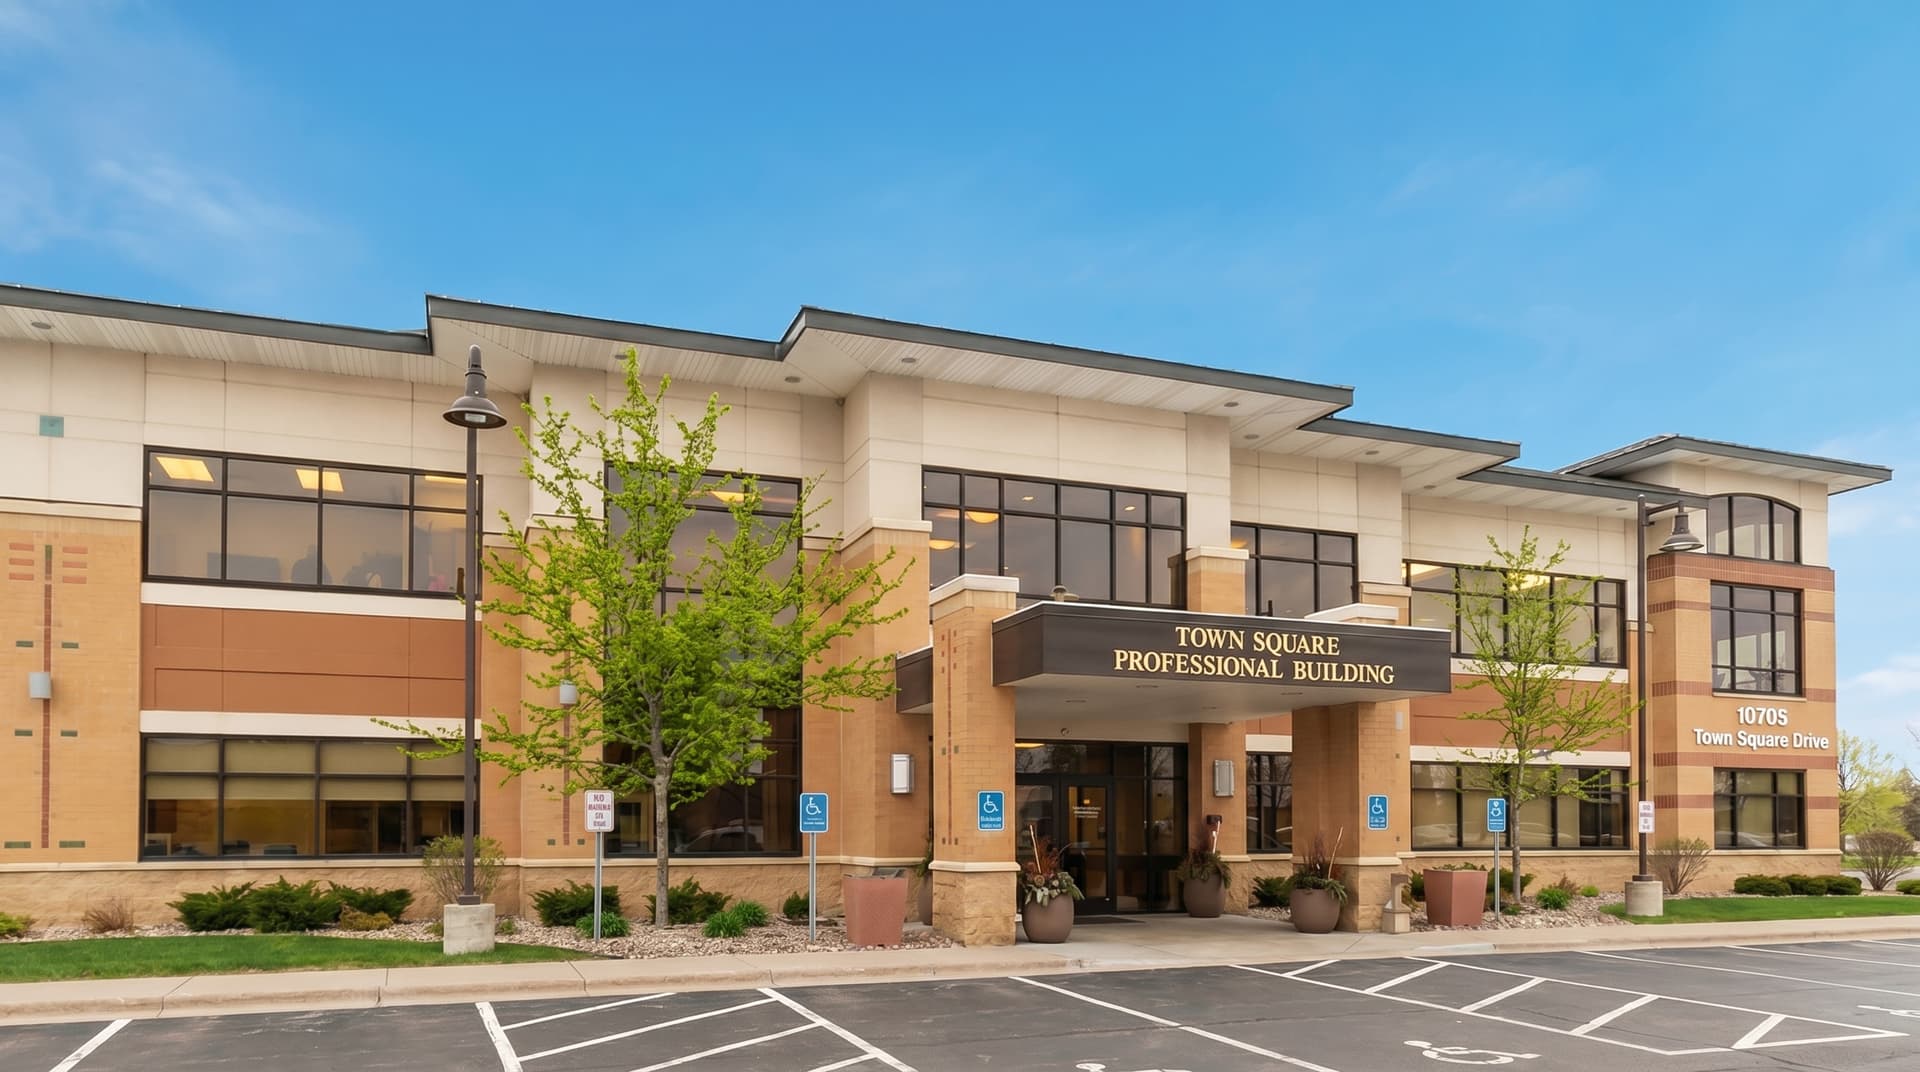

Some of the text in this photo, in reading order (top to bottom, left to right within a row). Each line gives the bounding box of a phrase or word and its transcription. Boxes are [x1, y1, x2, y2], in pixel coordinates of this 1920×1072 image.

[1175, 626, 1340, 656] TOWN SQUARE
[1113, 649, 1395, 685] PROFESSIONAL BUILDING
[1694, 728, 1829, 750] Town Square Drive
